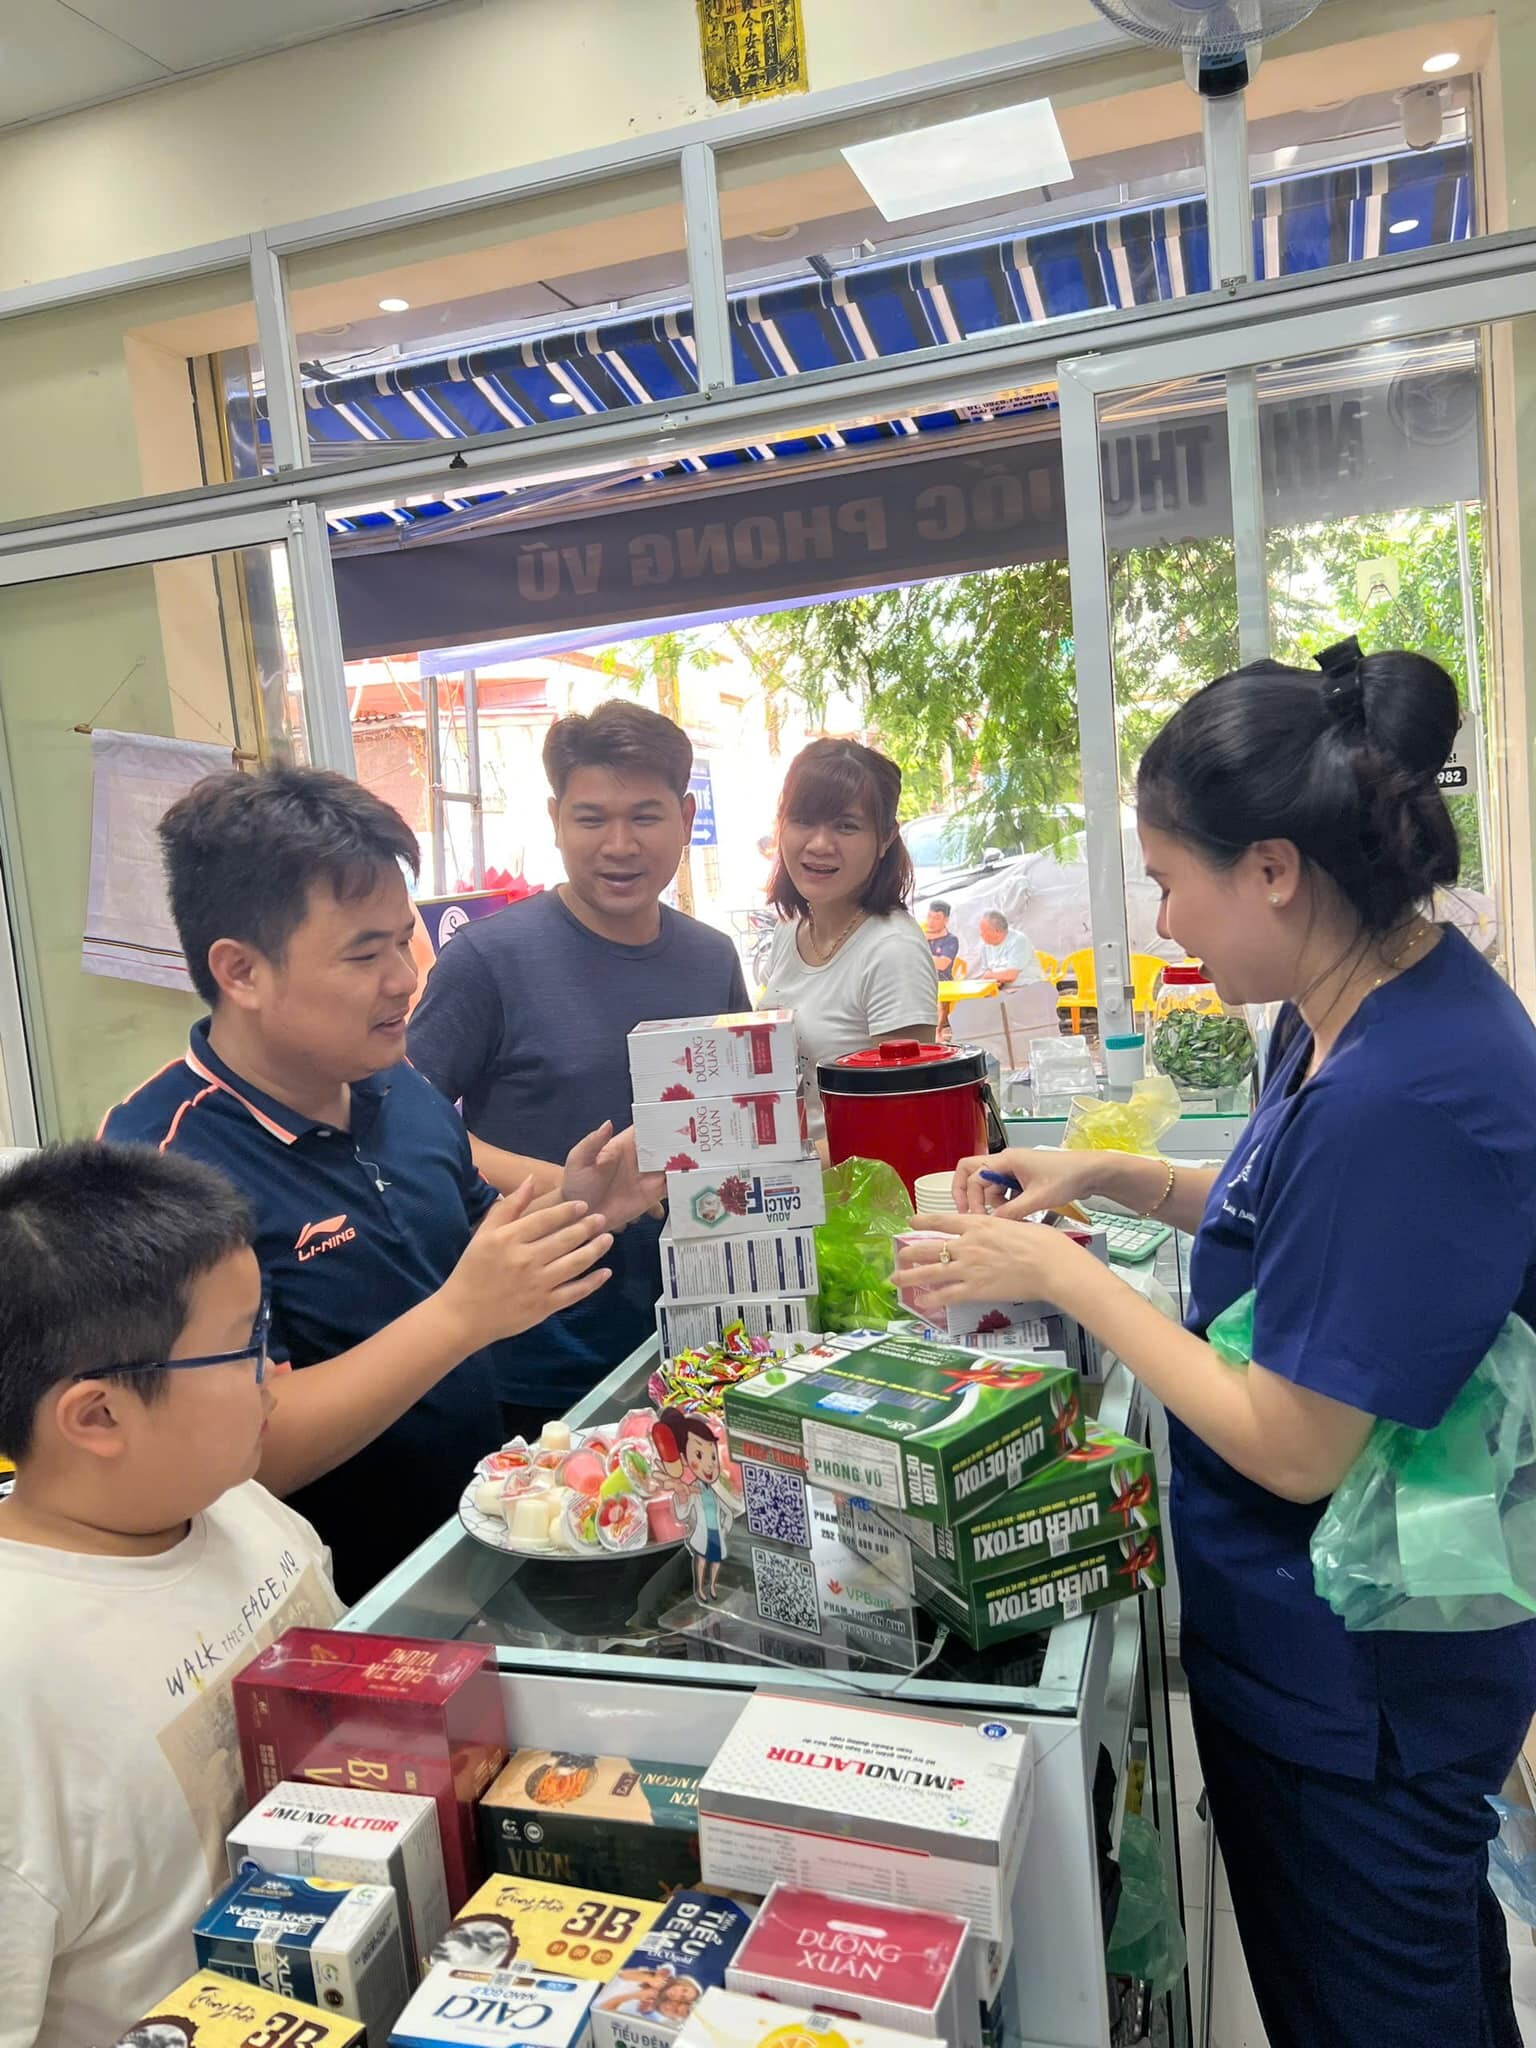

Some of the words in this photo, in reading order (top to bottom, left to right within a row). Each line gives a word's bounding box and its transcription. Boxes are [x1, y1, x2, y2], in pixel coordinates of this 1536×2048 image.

[764, 1196, 801, 1213] CALCI
[766, 1211, 791, 1223] AQUA
[298, 1227, 356, 1261] LI-NING
[1006, 1424, 1046, 1472] LIVER
[813, 1457, 861, 1484] PHONG
[865, 1469, 883, 1488] VŨ
[905, 1453, 925, 1507] DETOXI
[922, 1462, 939, 1506] LIVER
[954, 1452, 1006, 1501] DETOXI
[1046, 1501, 1101, 1539] LIVER
[973, 1521, 1045, 1563] DETOXI
[1058, 1563, 1111, 1602] LIVER
[987, 1581, 1059, 1627] DETOXI
[165, 1641, 224, 1697] WALK
[221, 1622, 246, 1653] THIS
[241, 1576, 288, 1633] FACE,
[560, 1901, 641, 1945] 3B
[433, 1994, 554, 2031] CALCI
